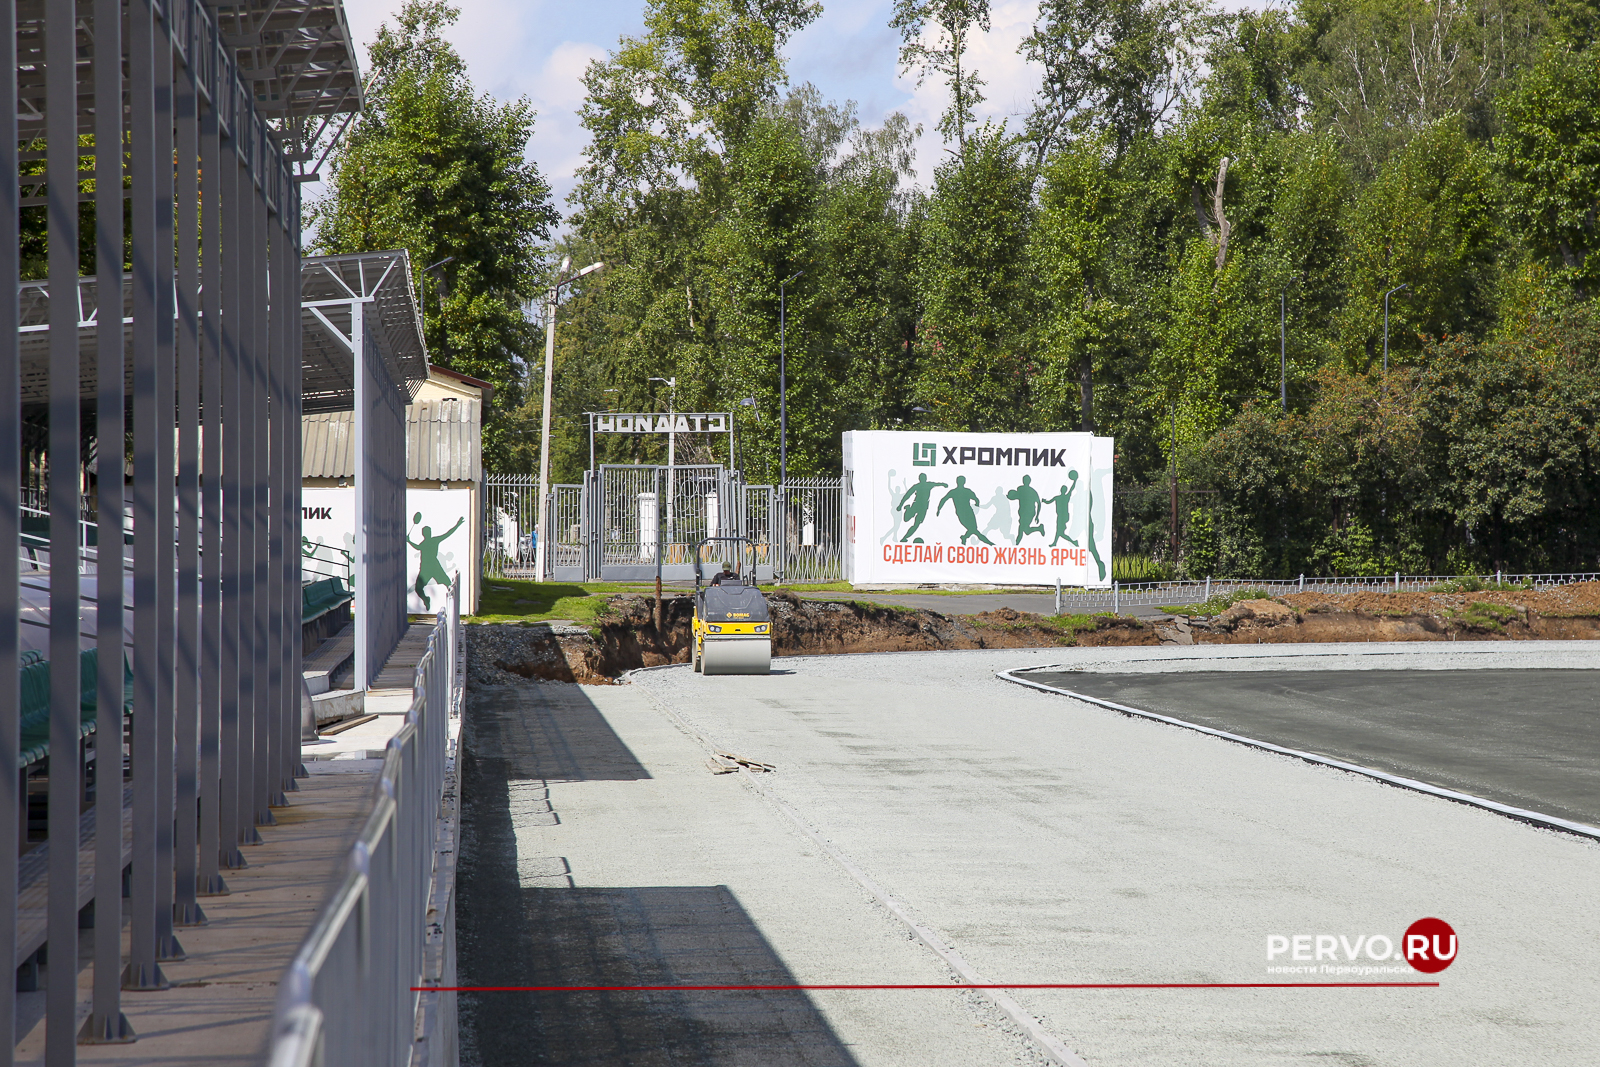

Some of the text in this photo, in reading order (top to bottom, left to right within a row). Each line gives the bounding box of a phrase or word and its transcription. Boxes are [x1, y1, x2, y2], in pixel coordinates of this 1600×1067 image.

[942, 446, 1067, 467] ХРОМПИК
[883, 542, 943, 564] СДЕЛАЙ
[947, 546, 989, 564] СВОЮ
[993, 547, 1046, 565] ЖИЗНЬ
